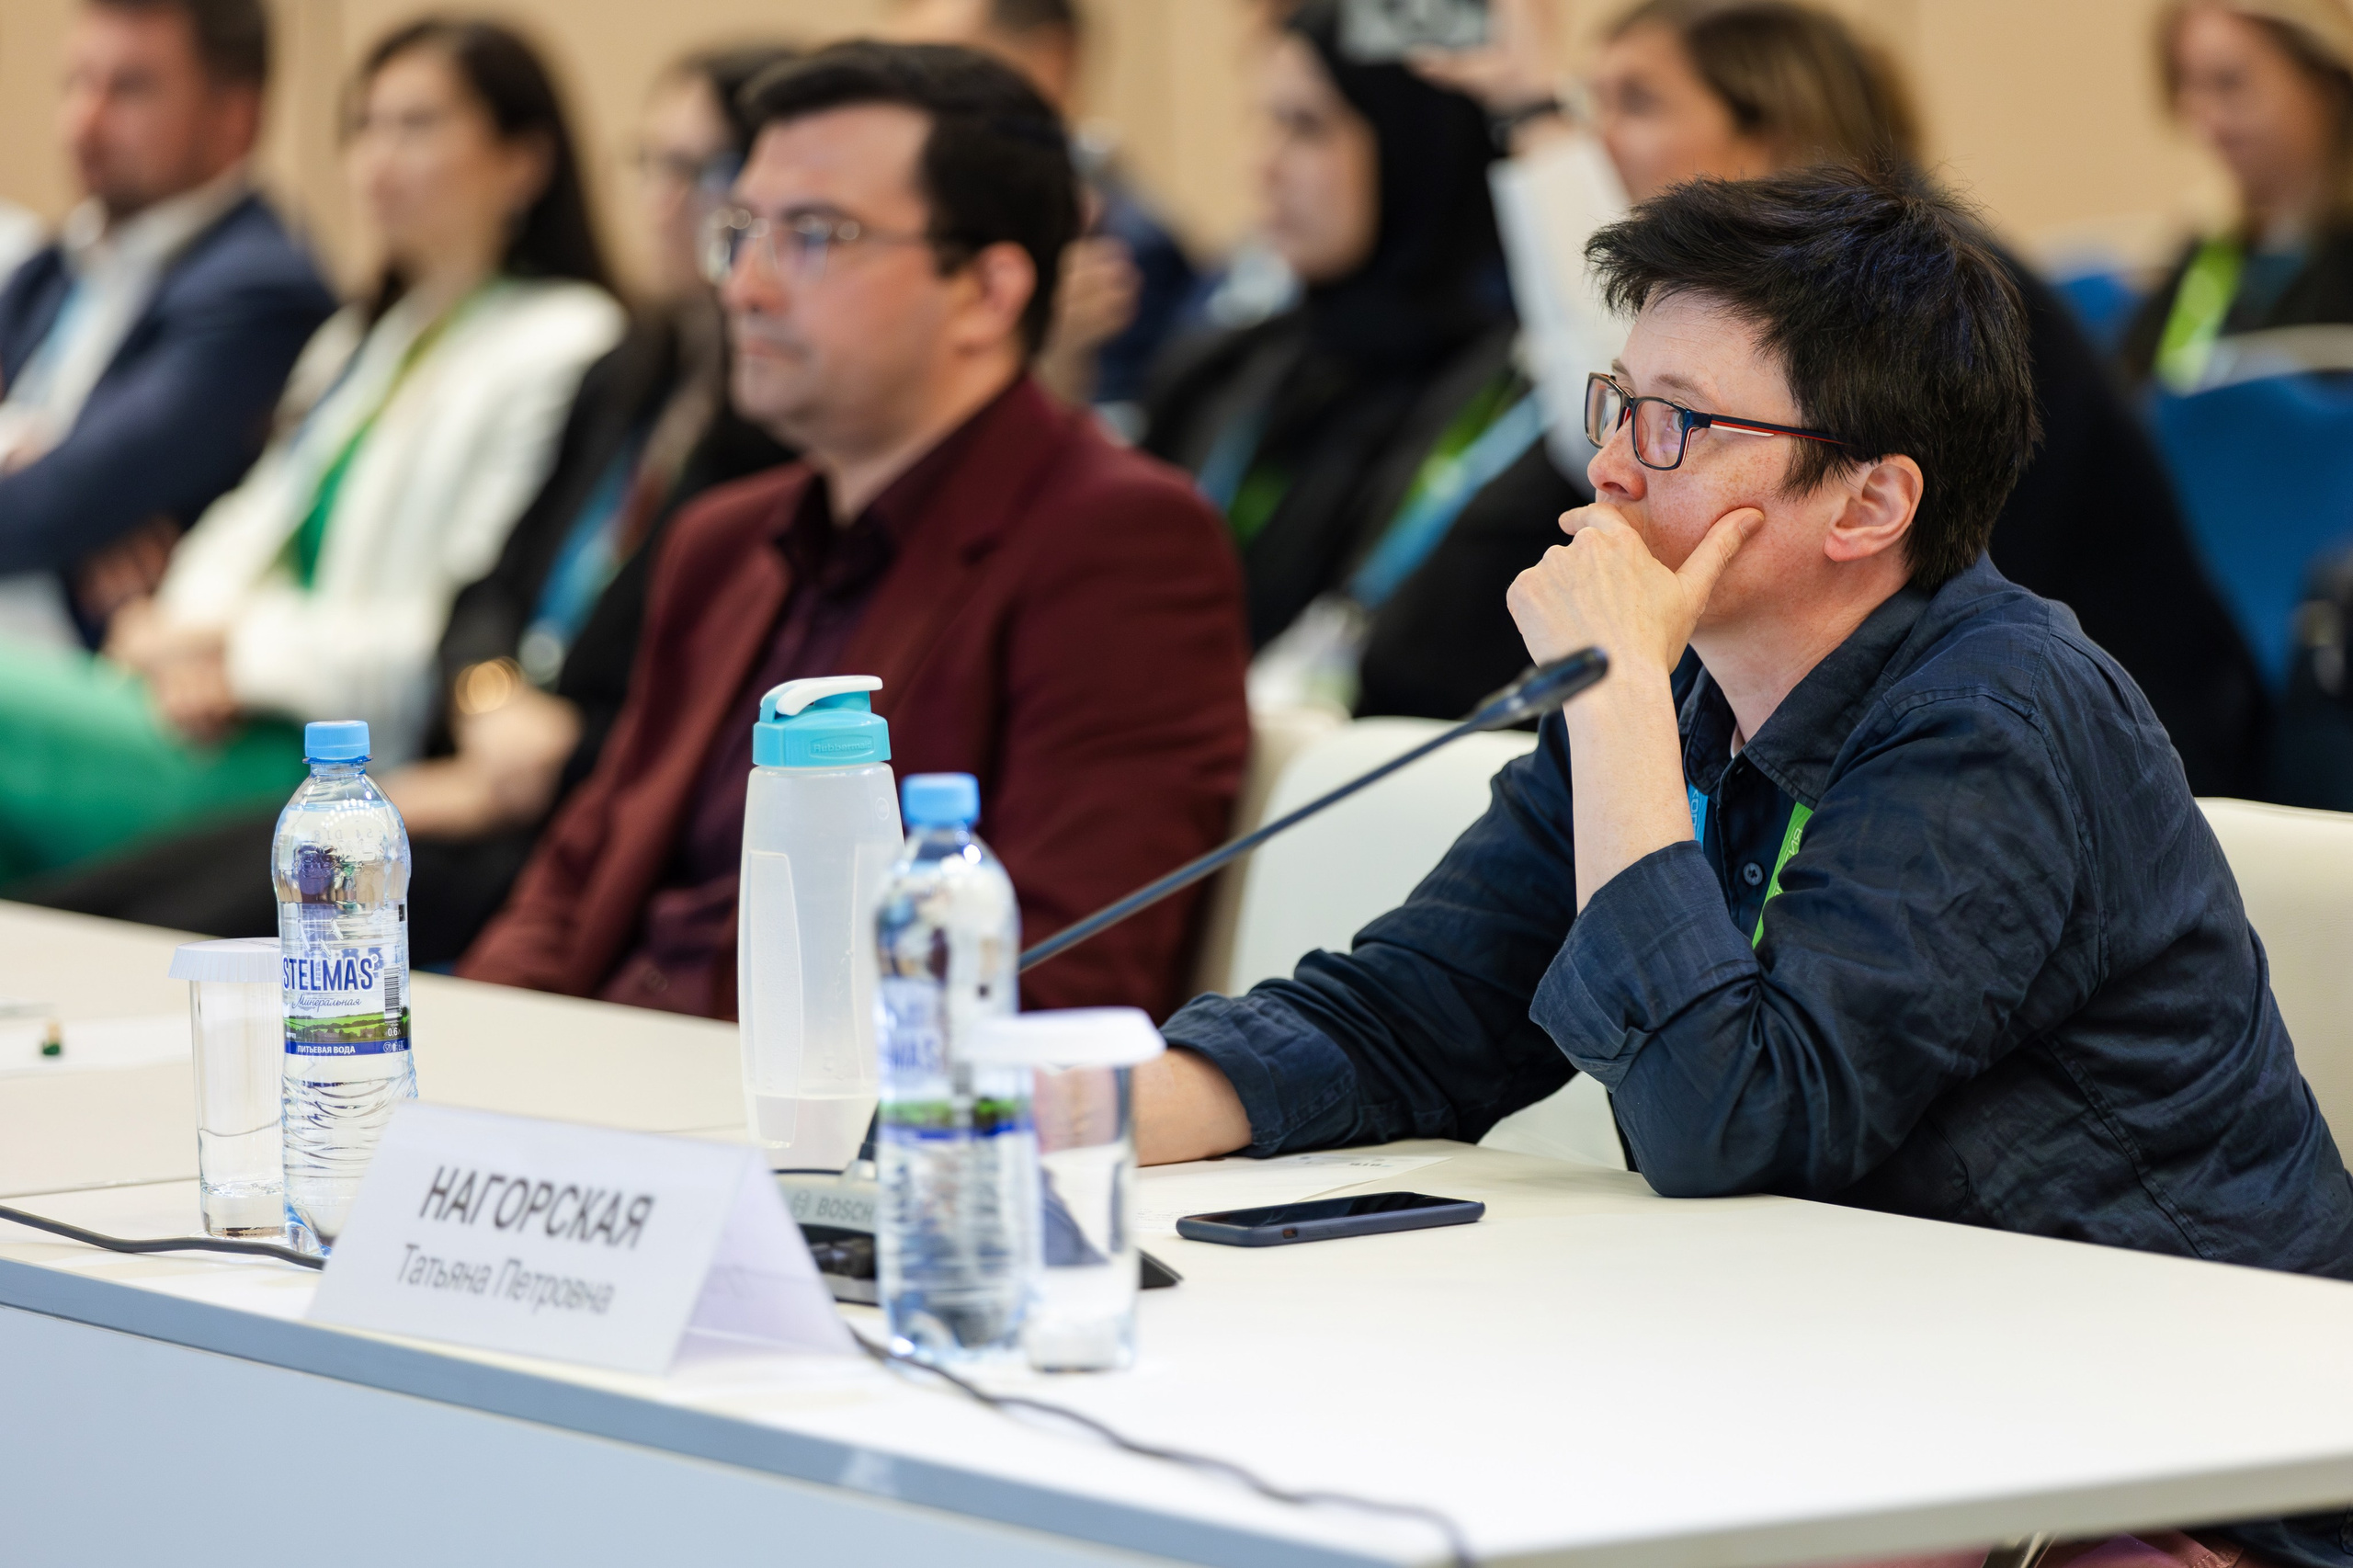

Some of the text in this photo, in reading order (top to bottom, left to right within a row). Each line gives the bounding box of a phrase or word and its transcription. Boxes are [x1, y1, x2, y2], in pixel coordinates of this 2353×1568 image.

[291, 994, 362, 1012] Минеральная
[297, 1044, 356, 1055] ПИТЬЕВАЯ ВОДА
[419, 1165, 655, 1249] НАГОРСКАЯ
[816, 1197, 874, 1222] BOSCH
[397, 1243, 616, 1314] Татьяна Петровна
